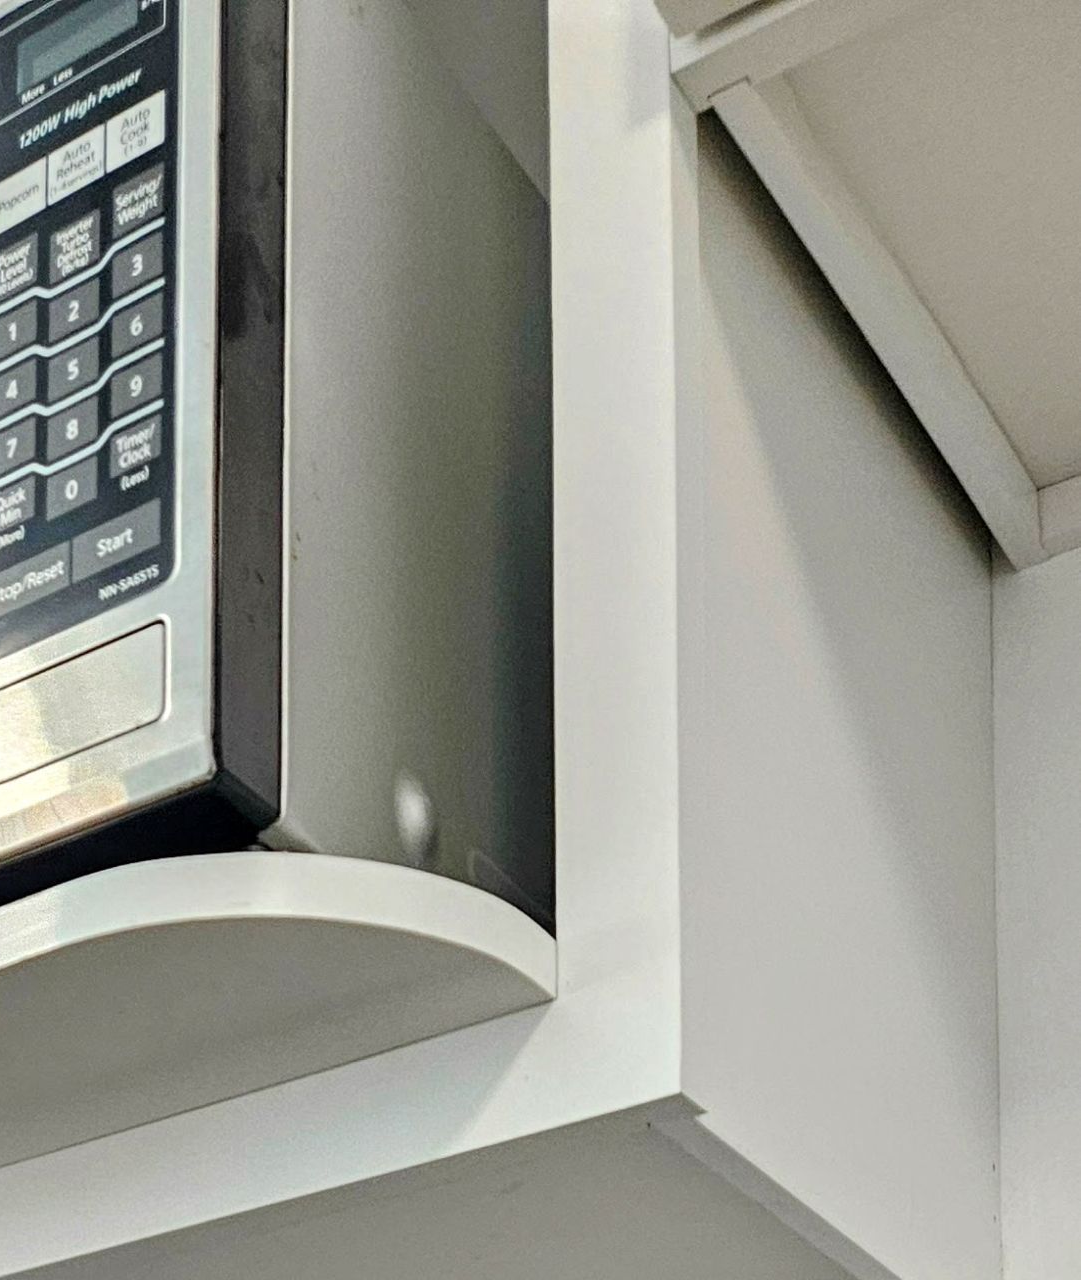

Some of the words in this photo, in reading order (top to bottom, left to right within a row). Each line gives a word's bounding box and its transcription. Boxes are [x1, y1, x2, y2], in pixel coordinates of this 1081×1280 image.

[21, 83, 45, 105] More
[20, 111, 61, 149] 1200W
[64, 91, 97, 124] High
[98, 67, 142, 104] Power
[121, 108, 151, 131] Auto
[120, 121, 150, 145] Cook
[63, 141, 91, 163] Auto
[56, 152, 96, 182] Reheat
[115, 174, 162, 211] Serving/
[118, 194, 158, 225] Weight
[55, 216, 94, 246] Inverter
[62, 232, 90, 253] Turbo
[0, 256, 27, 283] Level
[131, 254, 144, 277] 3
[68, 301, 80, 322] 2
[8, 322, 18, 341] 1
[130, 315, 144, 337] 6
[67, 358, 79, 380] 5
[5, 379, 19, 399] 4
[130, 375, 143, 397] 9
[66, 419, 79, 440] 8
[116, 423, 156, 452] Timer/
[6, 437, 18, 459] 7
[119, 443, 152, 468] Clock
[121, 465, 150, 491] (Less)
[65, 479, 79, 500] 0
[0, 507, 22, 528] Min
[96, 528, 134, 558] Start
